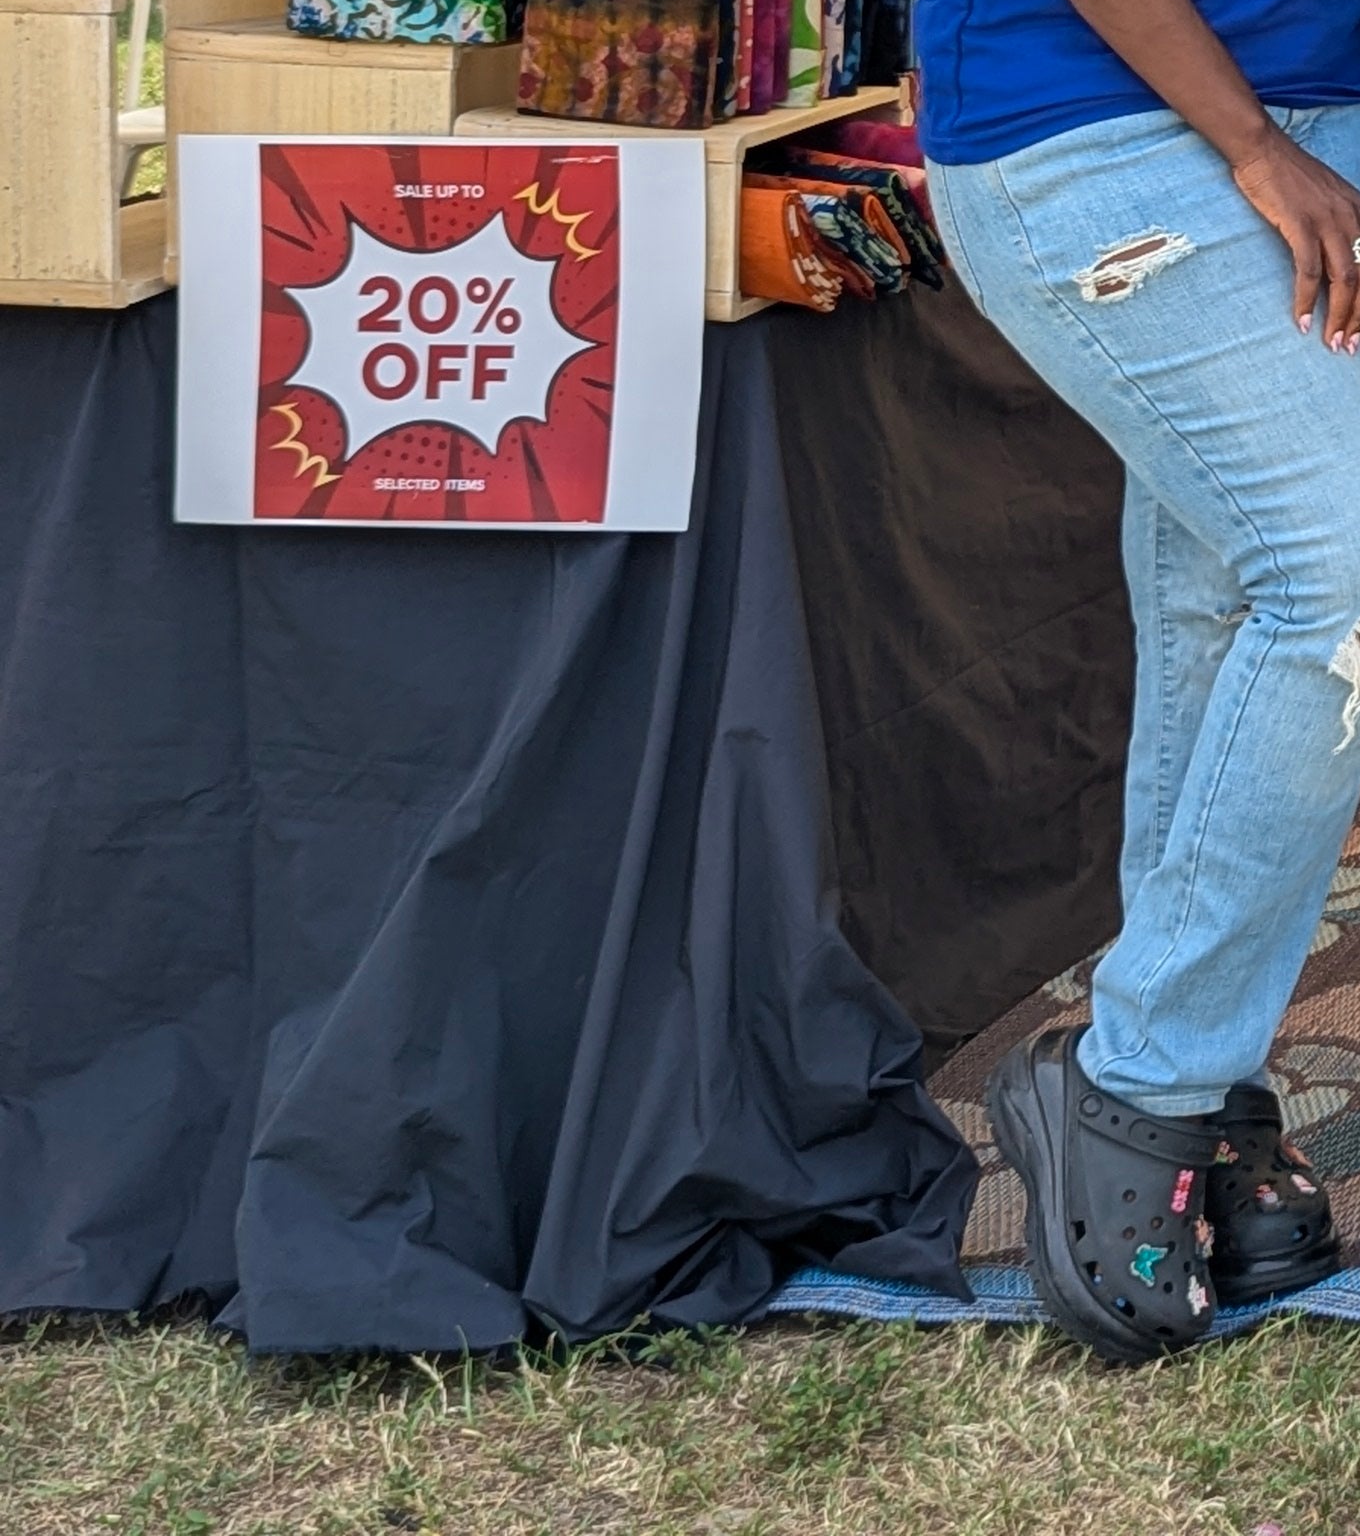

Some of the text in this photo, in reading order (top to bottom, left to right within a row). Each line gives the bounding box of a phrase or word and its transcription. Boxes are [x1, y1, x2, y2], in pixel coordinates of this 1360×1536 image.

[394, 184, 485, 198] SALE UP TO
[357, 276, 521, 335] 20%
[362, 342, 515, 400] OFF
[374, 478, 486, 491] SELECTED ITEMS
